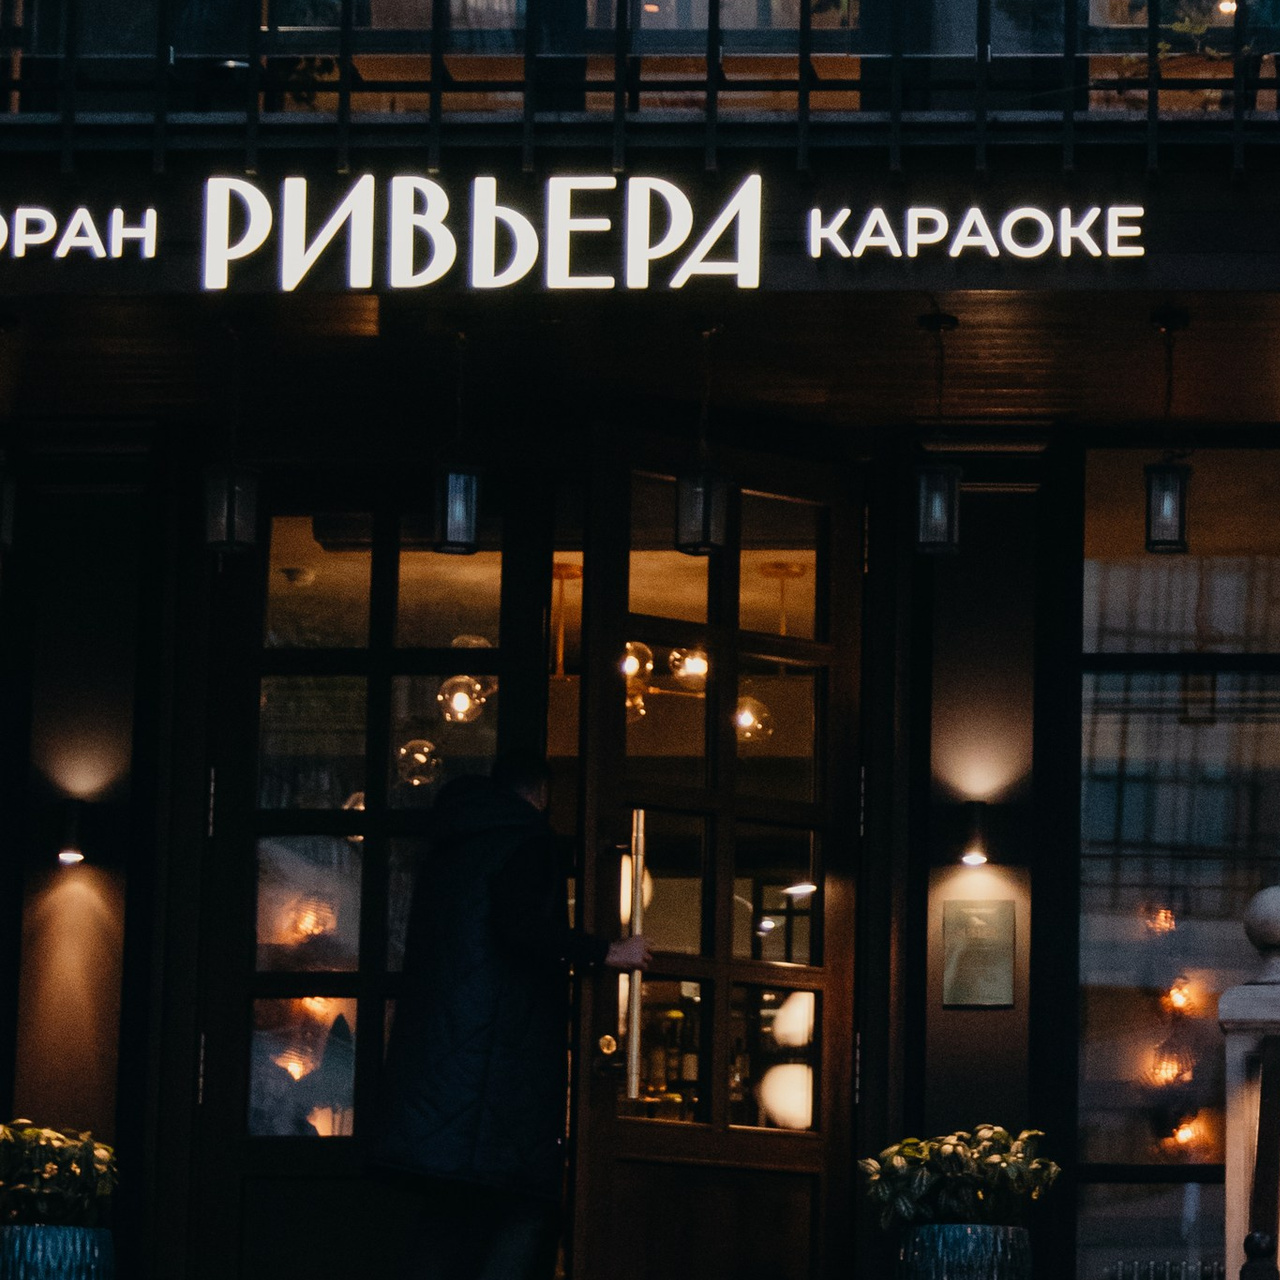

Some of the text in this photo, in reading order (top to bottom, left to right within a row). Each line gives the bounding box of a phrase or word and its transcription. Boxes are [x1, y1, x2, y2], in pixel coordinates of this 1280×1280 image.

[0, 173, 1146, 291] РАН РИВЬЕРА КАРАОКЕ
